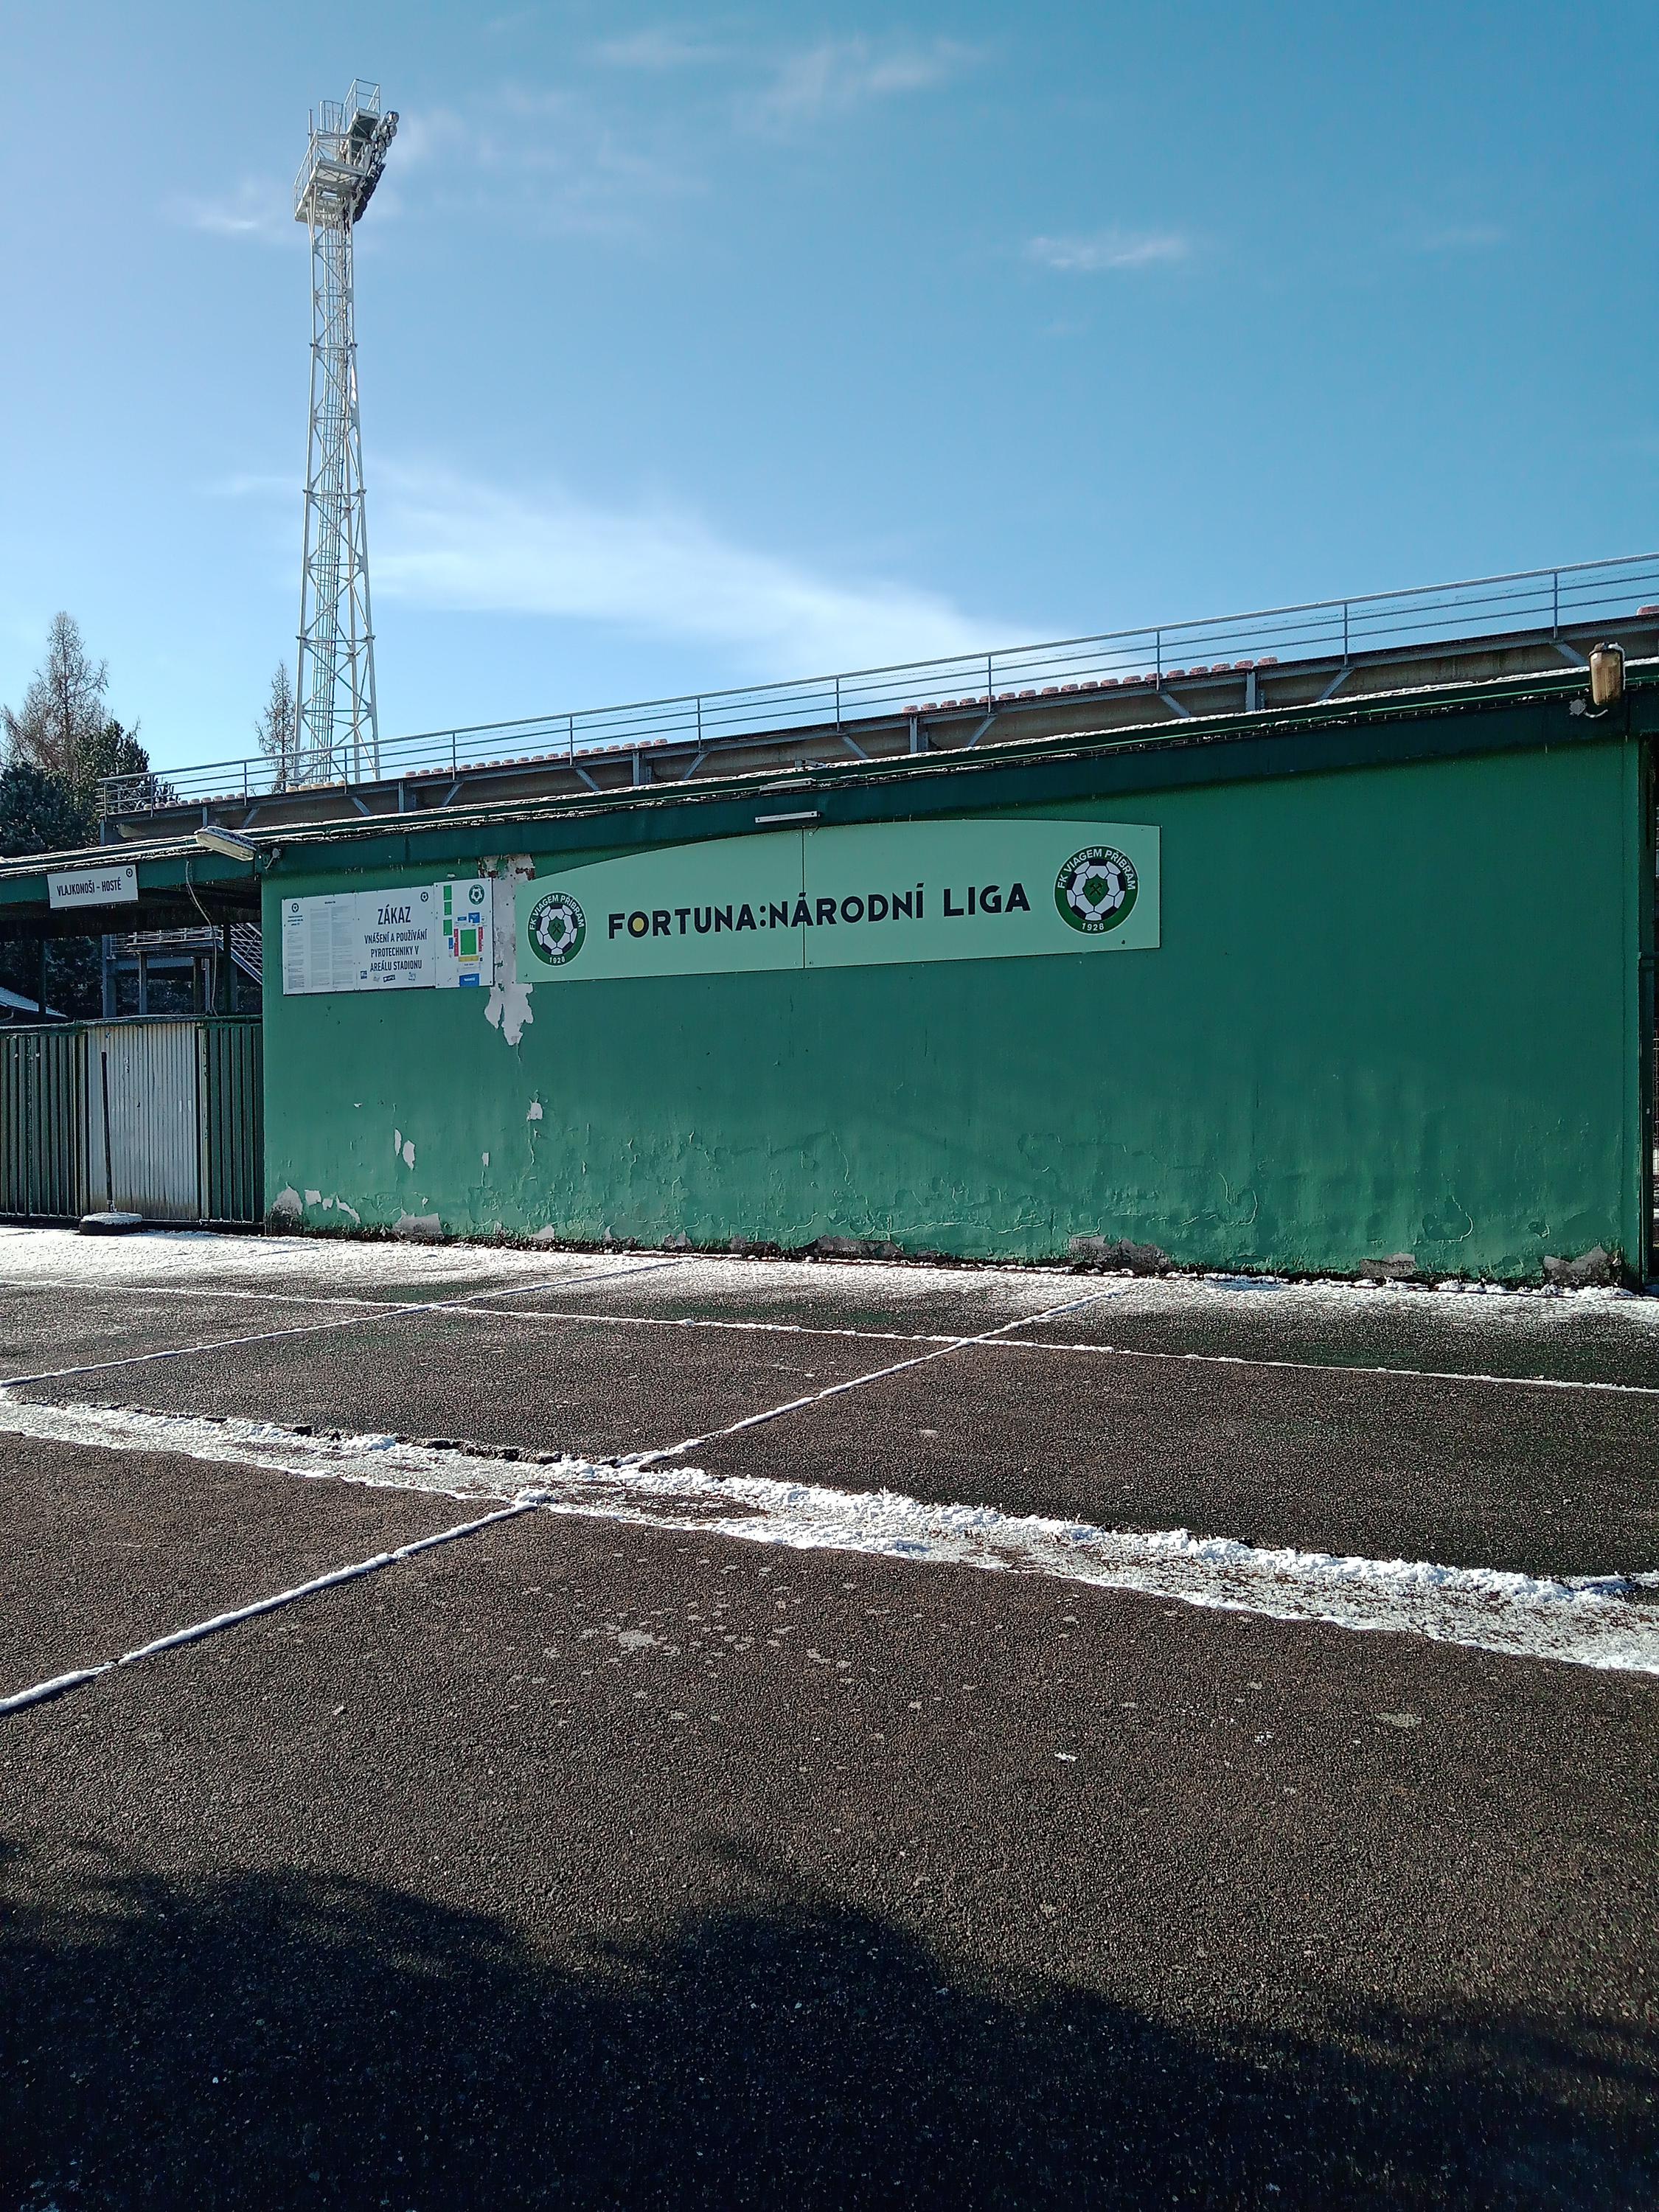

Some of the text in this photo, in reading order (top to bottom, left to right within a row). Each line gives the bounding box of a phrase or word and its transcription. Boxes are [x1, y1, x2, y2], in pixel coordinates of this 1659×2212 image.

[1057, 848, 1136, 891] FK VIAGEM PŘÍBRAM
[57, 880, 95, 897] VLAJKONOŠI
[102, 876, 122, 892] HOSTÉ
[532, 894, 559, 917] VIAGEM
[943, 883, 1031, 917] LIGA
[378, 904, 411, 925] ZÁKAZ
[529, 917, 537, 931] FK
[1082, 922, 1105, 931] 1928
[364, 928, 428, 944] VNÁŠENÍ A POUŽÍVÁNÍ
[371, 945, 419, 958] PYROTECHNIKY V
[370, 959, 422, 972] AREÁLU STADIONU
[549, 956, 566, 964] 1928
